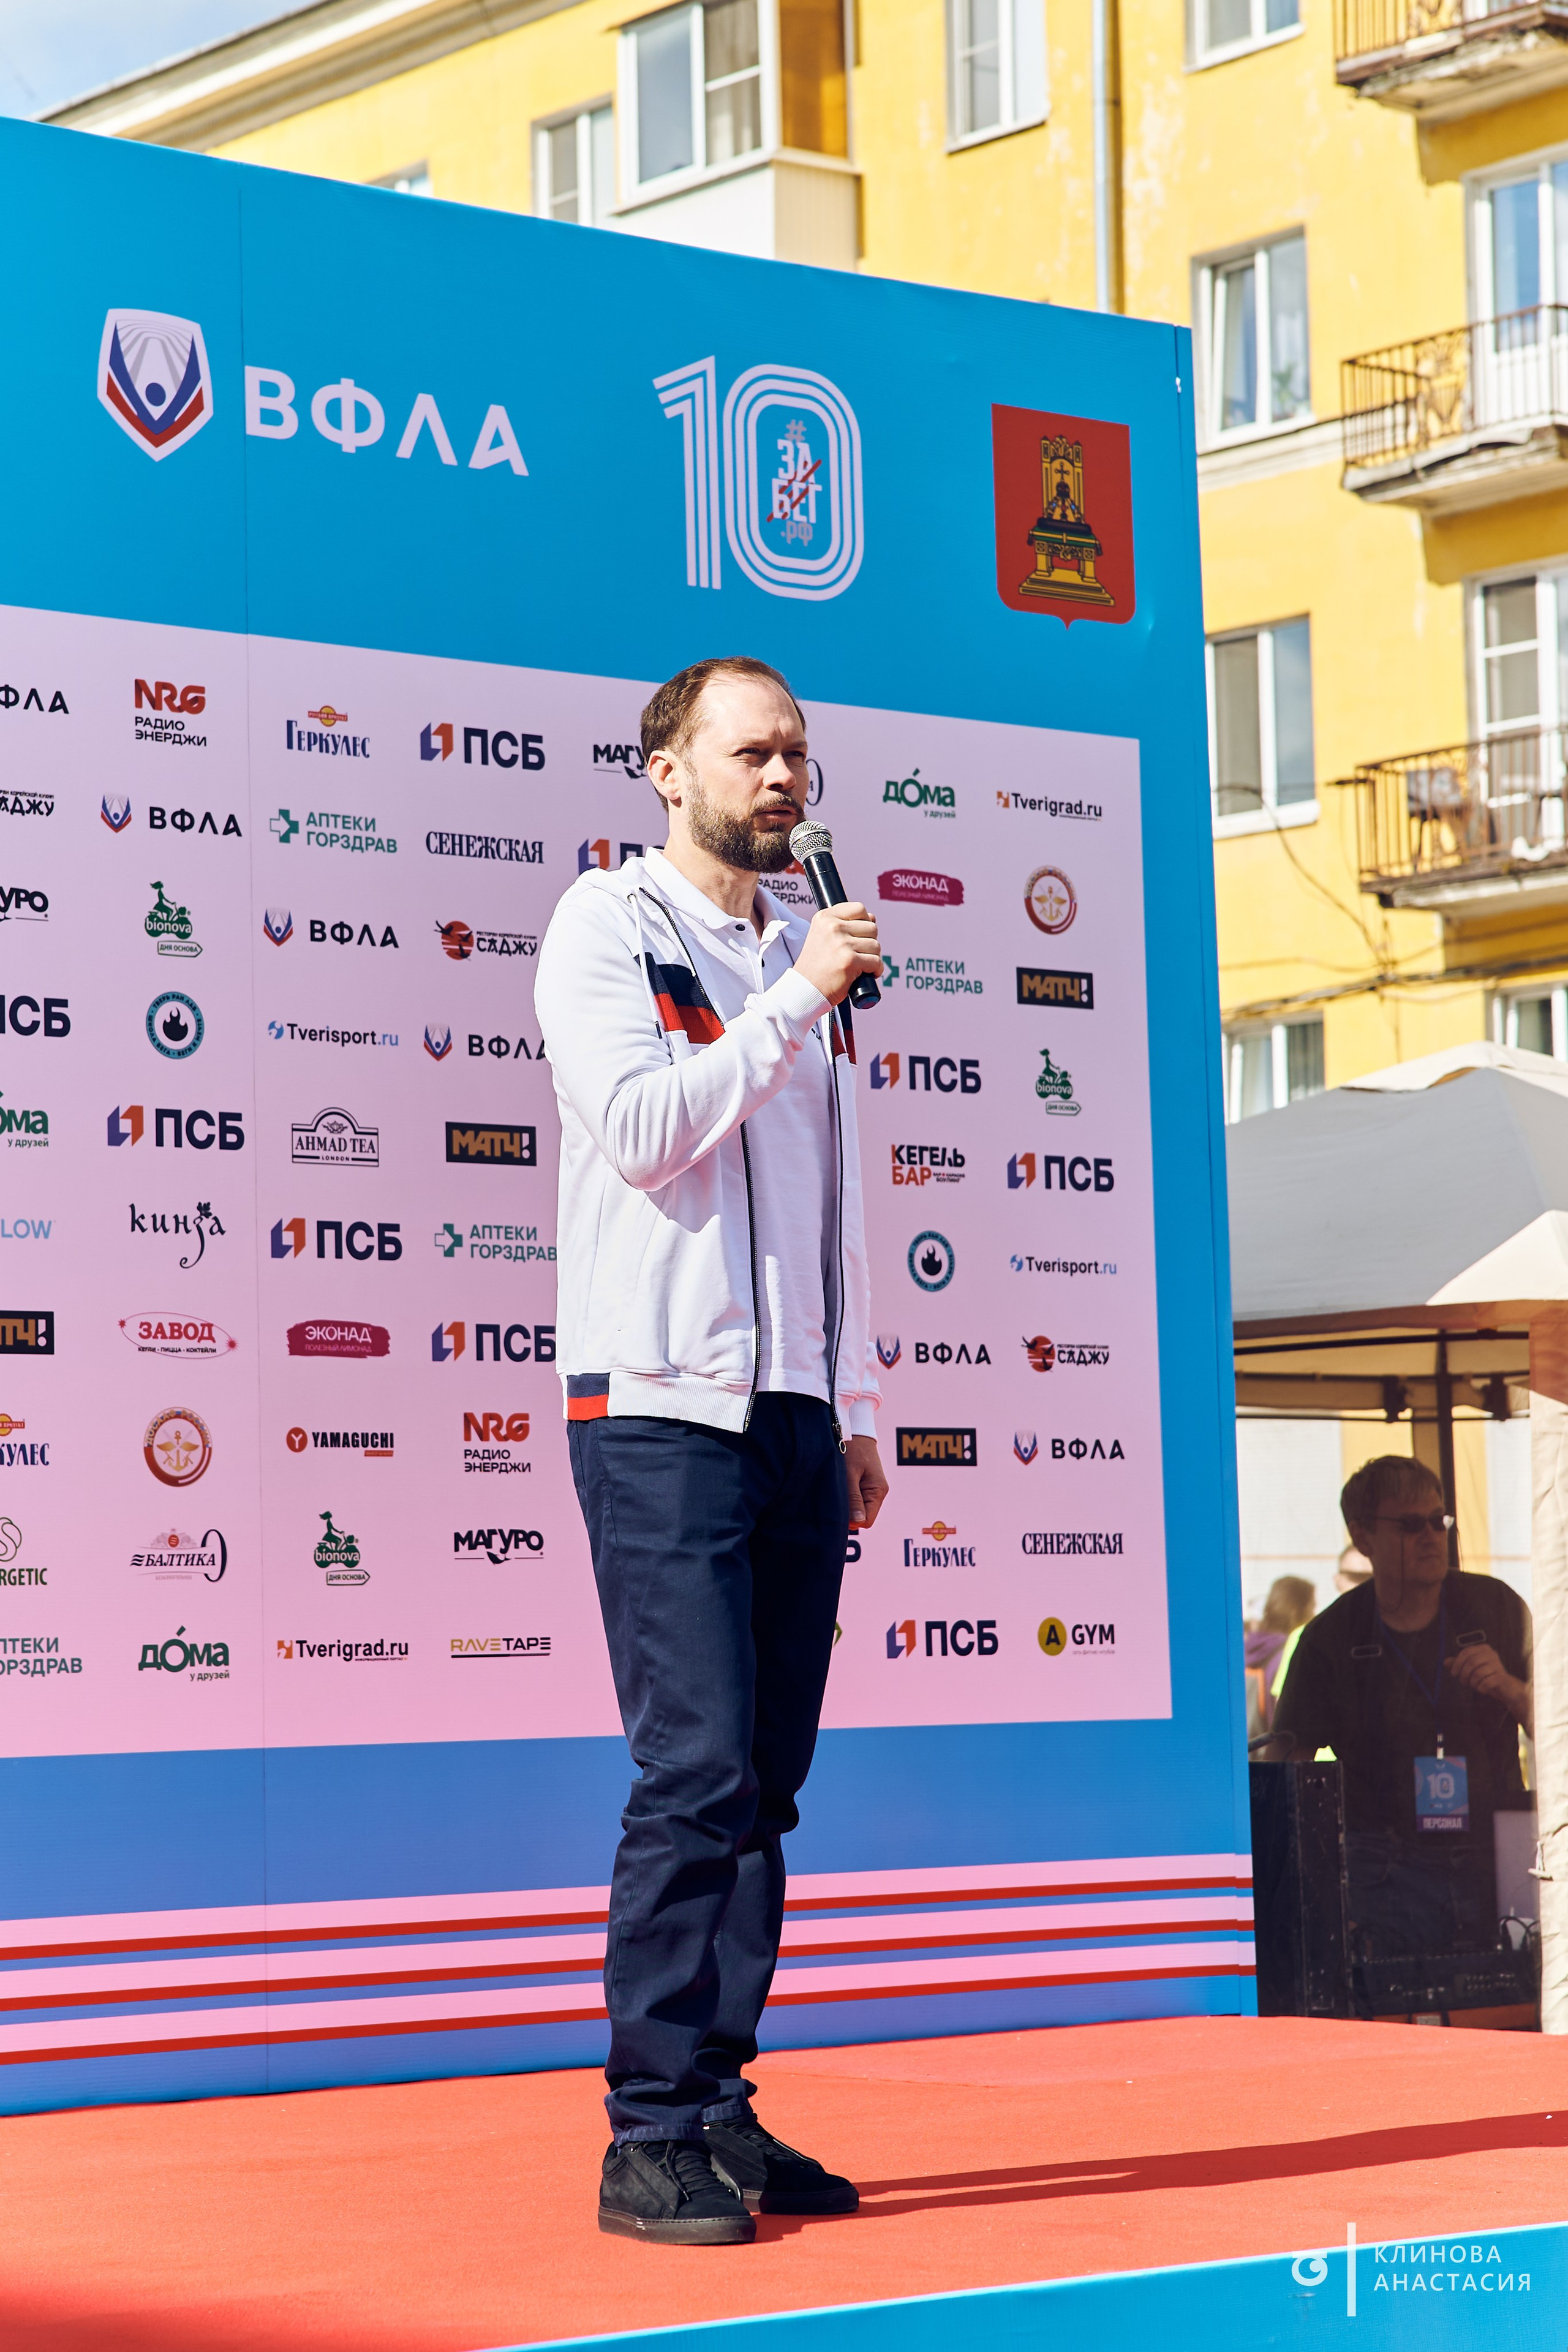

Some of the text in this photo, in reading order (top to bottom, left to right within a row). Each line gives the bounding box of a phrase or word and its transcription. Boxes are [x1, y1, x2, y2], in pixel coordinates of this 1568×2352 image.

[244, 364, 530, 477] ВФЛА
[777, 439, 816, 484] ЗА
[652, 355, 864, 601] 10
[135, 679, 206, 715] NRG
[135, 716, 186, 731] РАДИО
[135, 729, 207, 747] ЭНЕРДЖИ
[464, 727, 546, 771] ПСБ
[930, 809, 956, 819] друзей
[1011, 793, 1102, 817] Tverigrad.ru
[149, 806, 243, 837] ВФЛА
[306, 812, 376, 832] АПТЕКИ
[307, 831, 398, 853] ГОРЗДРАВ
[426, 831, 544, 864] СЕНЕЖСКАЯ
[146, 918, 192, 933] bionova
[310, 919, 399, 948] ВФЛА
[477, 938, 537, 957] САДЖУ
[906, 957, 965, 976] АПТЕКИ
[907, 975, 983, 995] ГОРЗДРАВ
[1022, 974, 1088, 1003] МАТЧ!
[287, 1023, 399, 1047] Tverisport.ru
[909, 1055, 981, 1094] ПСБ
[1036, 1081, 1072, 1095] bionova
[156, 1108, 244, 1150] ПСБ
[15, 1137, 49, 1148] друзей
[295, 1136, 376, 1153] AHMAD TEA
[452, 1129, 530, 1159] МАТЧ!
[891, 1144, 965, 1167] КЕГЕЛЬ
[892, 1165, 932, 1186] БАР
[1044, 1155, 1114, 1192] ПСБ
[317, 1220, 402, 1261] ПСБ
[470, 1224, 537, 1241] АПТЕКИ
[470, 1244, 557, 1262] ГОРЗДРАВ
[1026, 1256, 1117, 1276] Tverisport.ru
[0, 1319, 47, 1346] ТЧ!
[138, 1321, 216, 1343] ЗАВОД
[306, 1325, 372, 1343] ЭКОНАД
[476, 1324, 556, 1363] ПСБ
[915, 1342, 992, 1365] ВФЛА
[1058, 1349, 1109, 1366] САДЖУ
[464, 1412, 530, 1442] NRG
[312, 1432, 394, 1449] YAMAGUCHI
[902, 1434, 971, 1460] МАТЧ!
[1052, 1438, 1125, 1460] ВФЛА
[464, 1449, 511, 1461] РАДИО
[464, 1461, 531, 1474] ЭНЕРДЖИ
[454, 1529, 544, 1554] МАГУРО
[1022, 1532, 1123, 1555] СЕНЕЖСКАЯ
[145, 1553, 216, 1566] БАЛТИКА
[315, 1549, 359, 1561] bionova
[925, 1619, 998, 1656] ПСБ
[1046, 1624, 1115, 1645] A GYM
[296, 1638, 409, 1662] Tverigrad.ru
[190, 1670, 230, 1681] у друзей
[1423, 1817, 1462, 1829] ПЕРСОНАЛ
